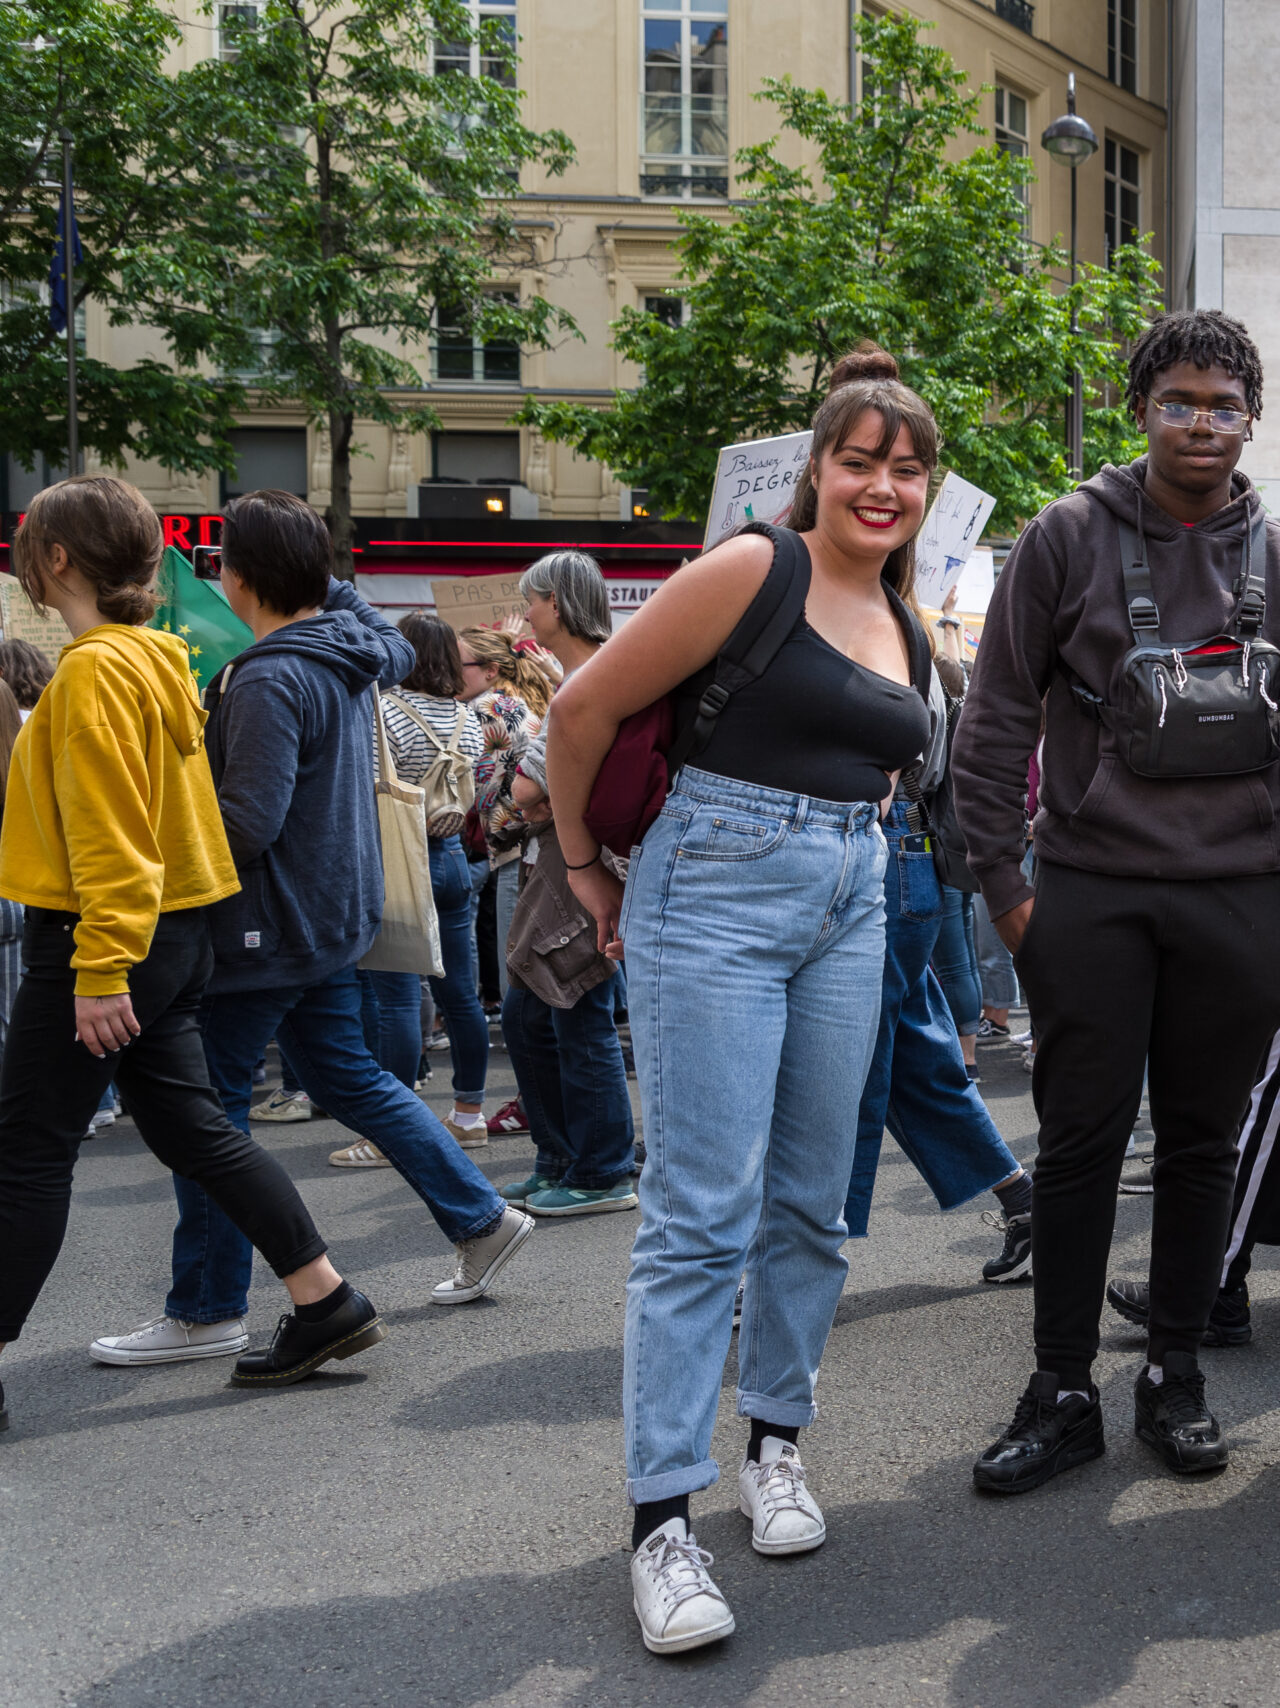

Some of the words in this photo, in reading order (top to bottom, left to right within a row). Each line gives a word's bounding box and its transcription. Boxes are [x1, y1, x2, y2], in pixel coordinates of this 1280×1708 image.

[724, 454, 782, 477] Baissez
[452, 584, 493, 602] PAS
[607, 587, 657, 602] STAU
